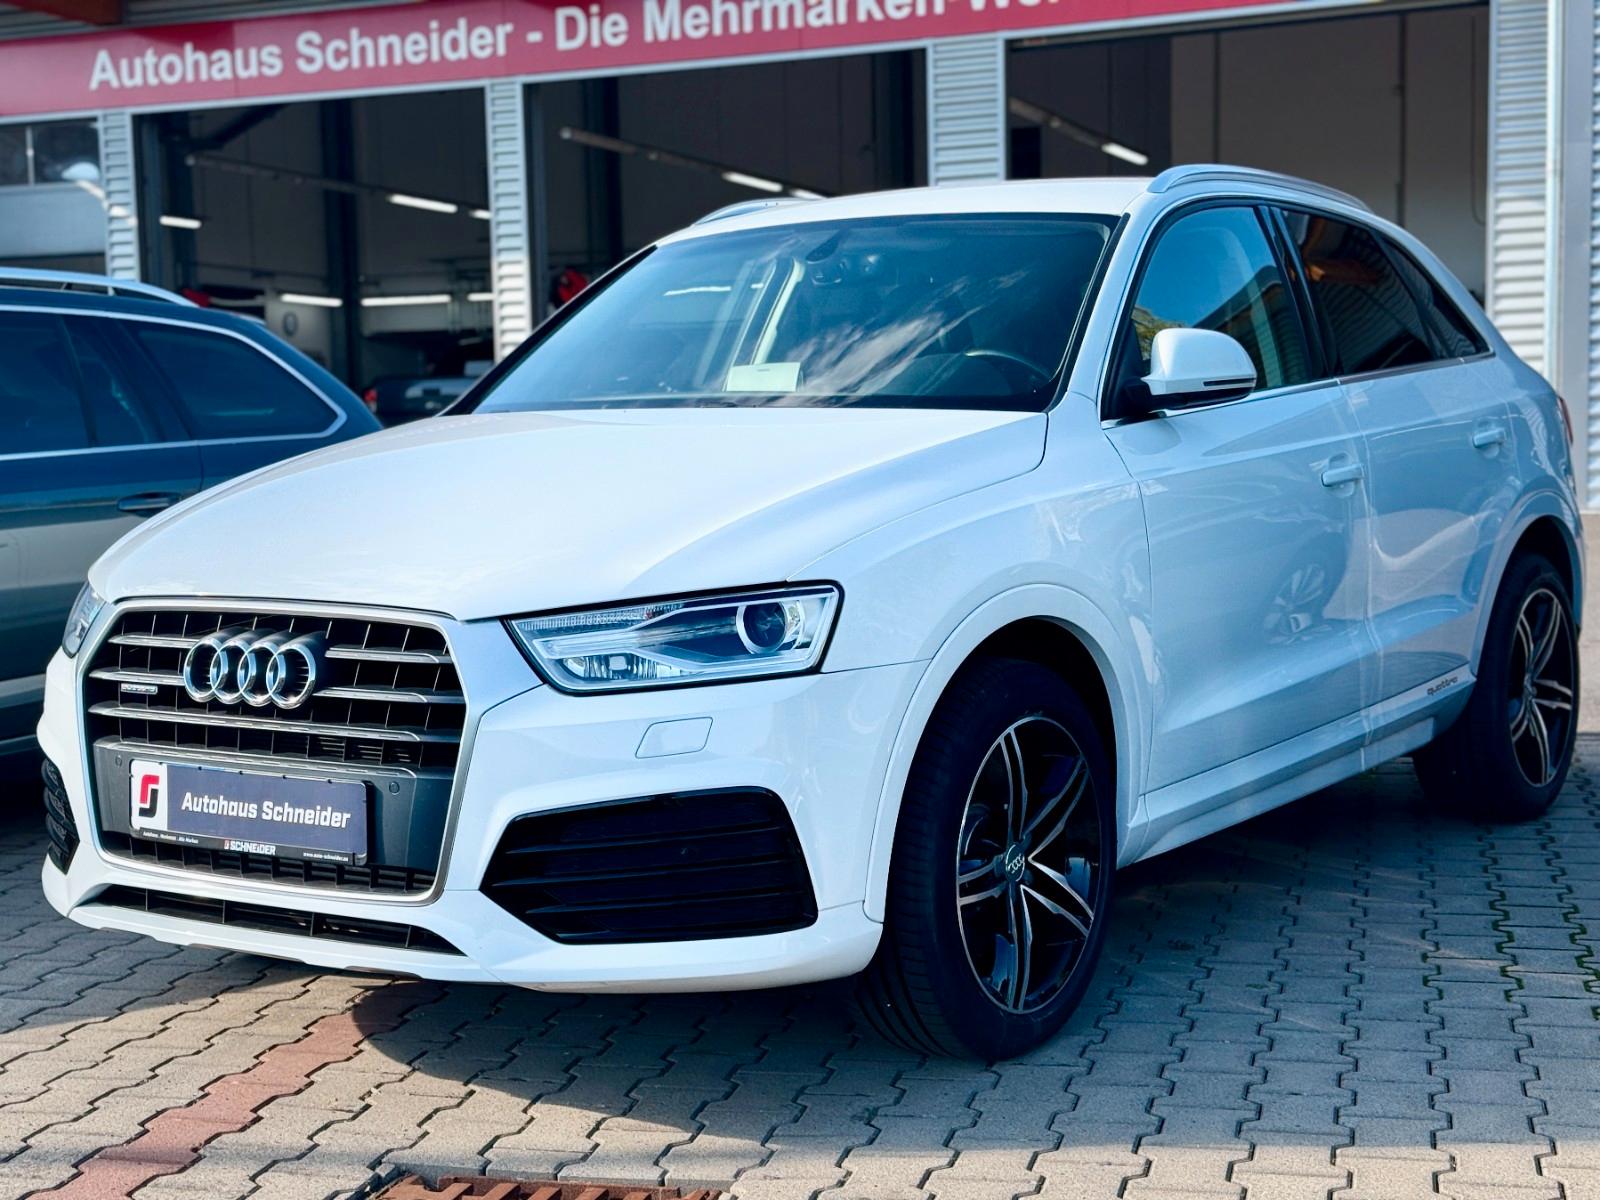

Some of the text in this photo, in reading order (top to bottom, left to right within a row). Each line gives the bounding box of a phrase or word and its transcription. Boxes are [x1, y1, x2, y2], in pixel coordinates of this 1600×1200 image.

[89, 42, 283, 90] Autohaus
[296, 18, 514, 74] Schneider
[555, 4, 629, 50] Die
[181, 792, 352, 828] Autohaus Schneider
